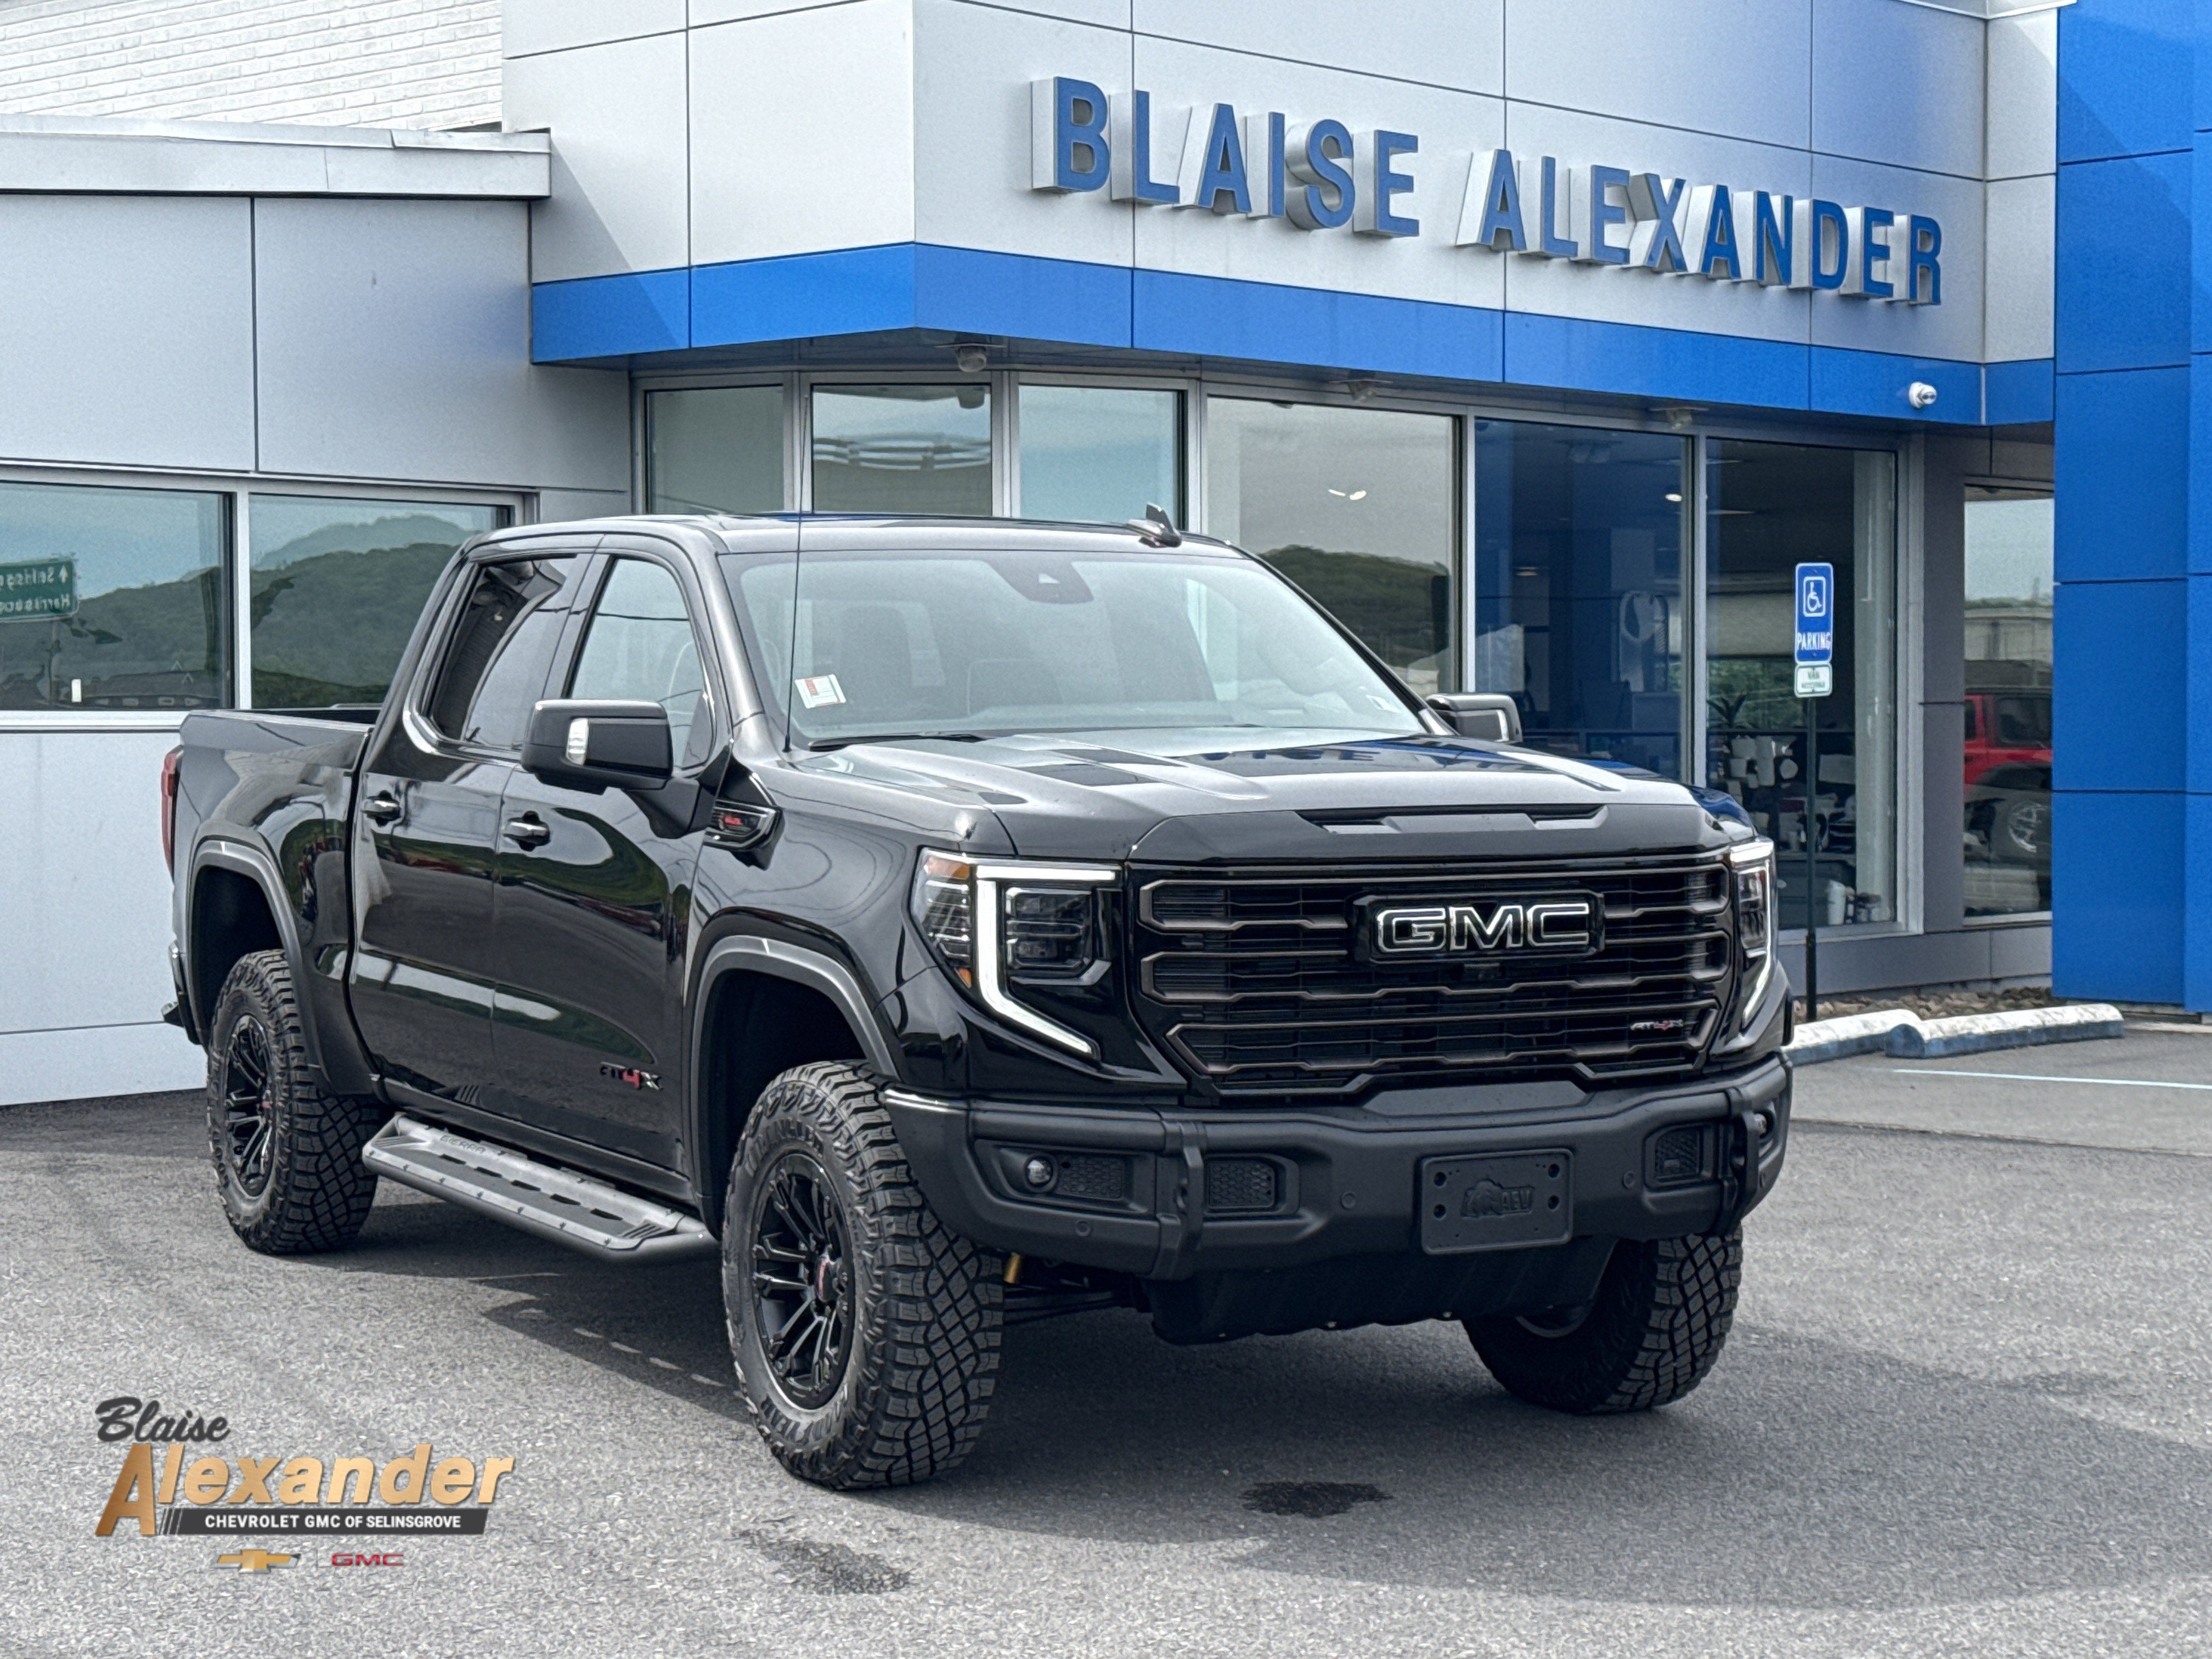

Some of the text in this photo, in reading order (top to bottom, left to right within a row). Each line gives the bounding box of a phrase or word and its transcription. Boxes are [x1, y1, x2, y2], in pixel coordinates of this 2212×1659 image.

[1052, 76, 1942, 306] BLAISE ALEXANDER
[1796, 632, 1831, 651] PARKING
[1376, 903, 1590, 953] GMC
